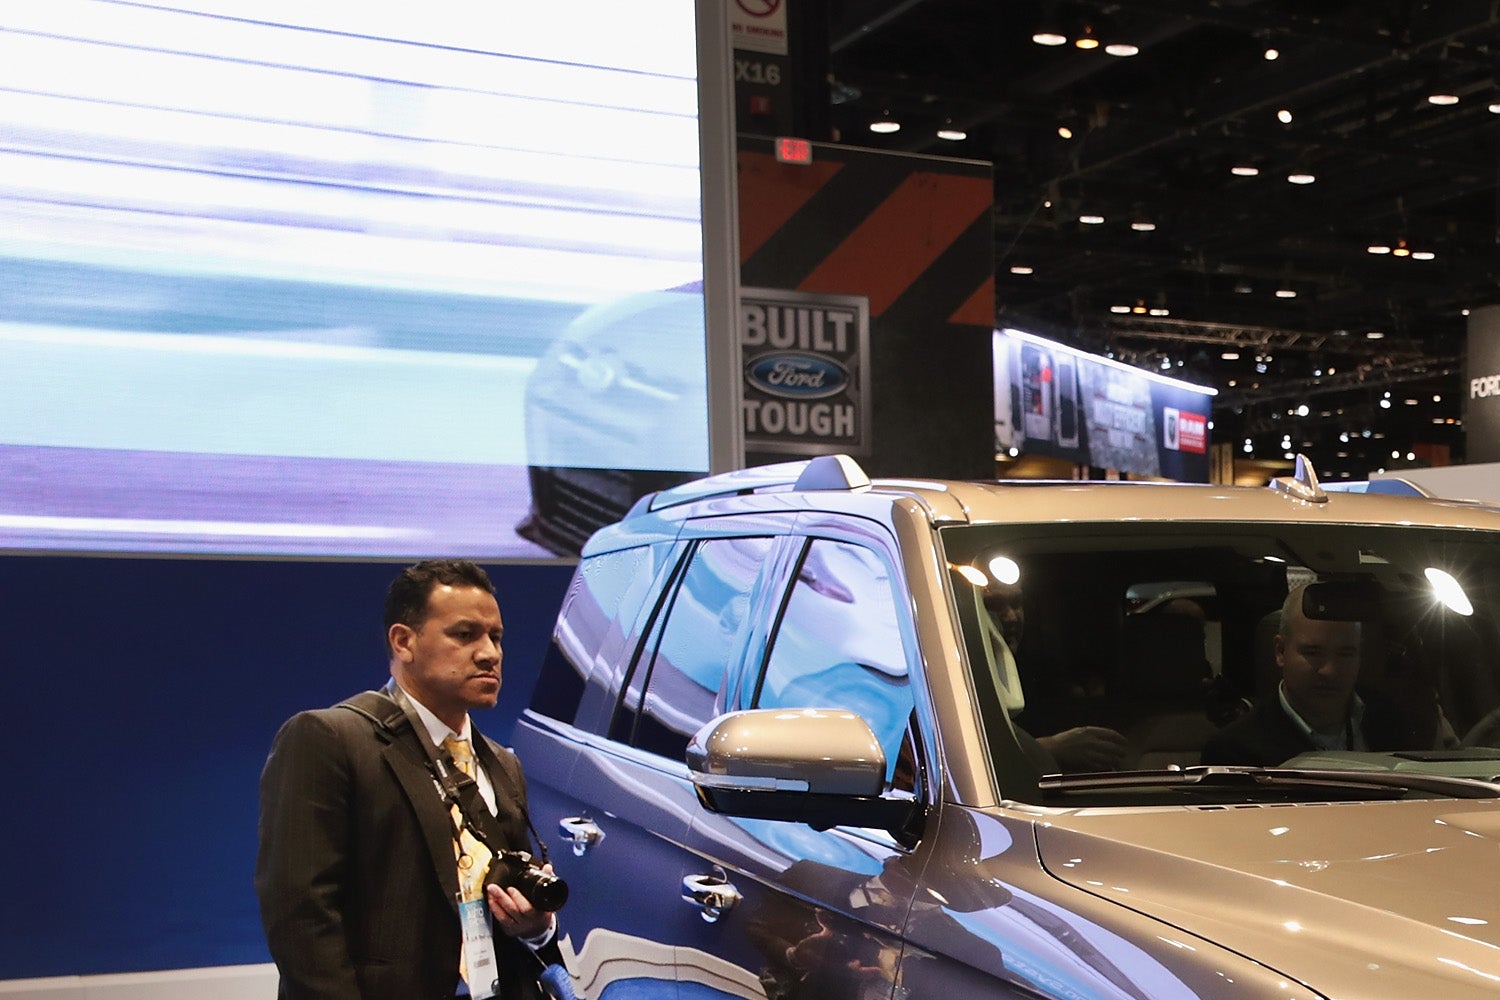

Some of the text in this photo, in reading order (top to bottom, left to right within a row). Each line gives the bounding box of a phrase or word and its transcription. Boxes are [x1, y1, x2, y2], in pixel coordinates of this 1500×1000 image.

[741, 304, 854, 352] BUILT
[767, 359, 827, 388] Ford
[740, 400, 855, 437] TOUGH
